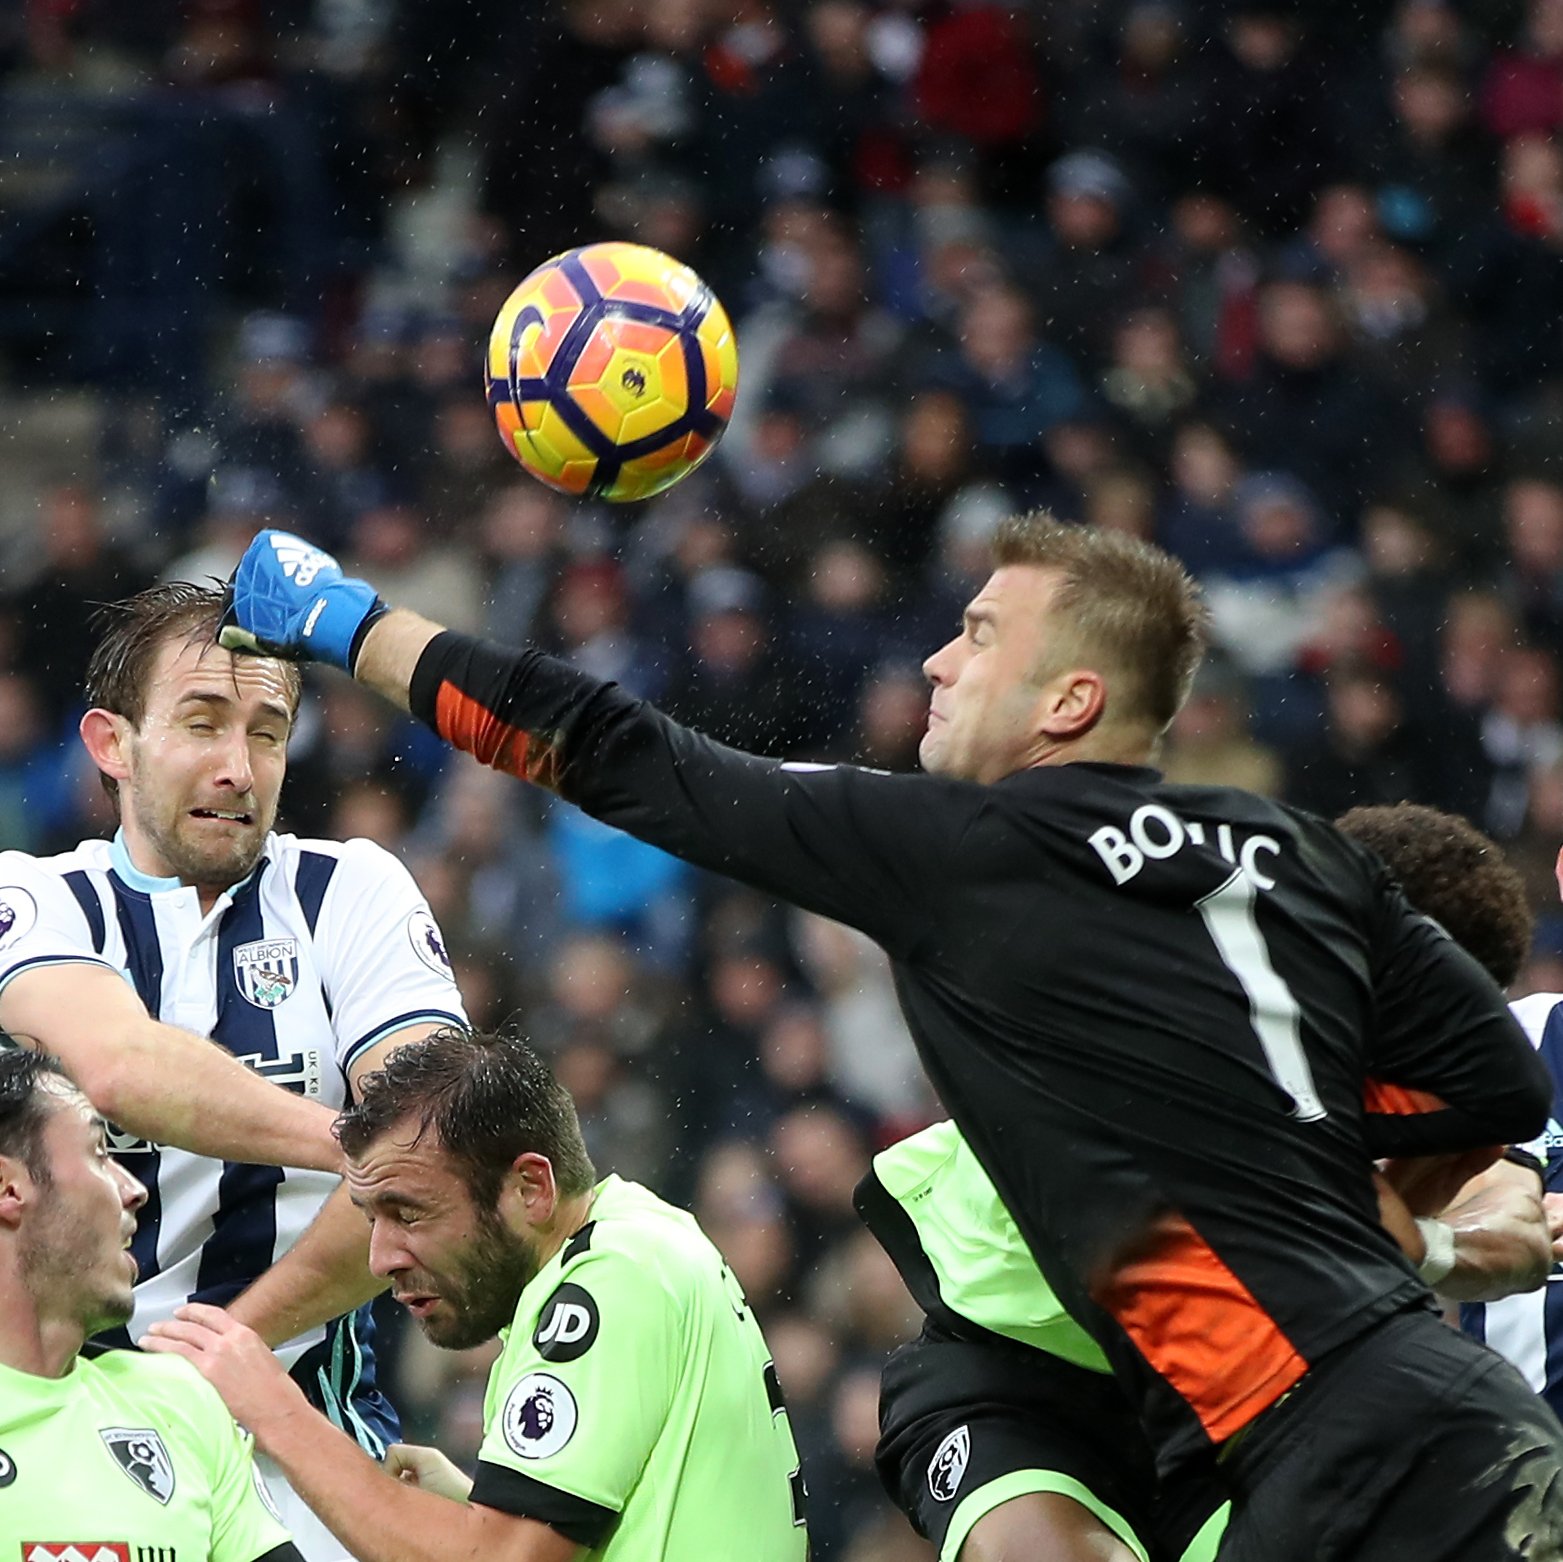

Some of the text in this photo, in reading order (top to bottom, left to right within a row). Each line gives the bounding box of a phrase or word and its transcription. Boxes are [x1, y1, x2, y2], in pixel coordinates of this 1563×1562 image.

[239, 946, 293, 965] ALBION
[1194, 866, 1329, 1123] 1
[539, 1302, 591, 1344] JD
